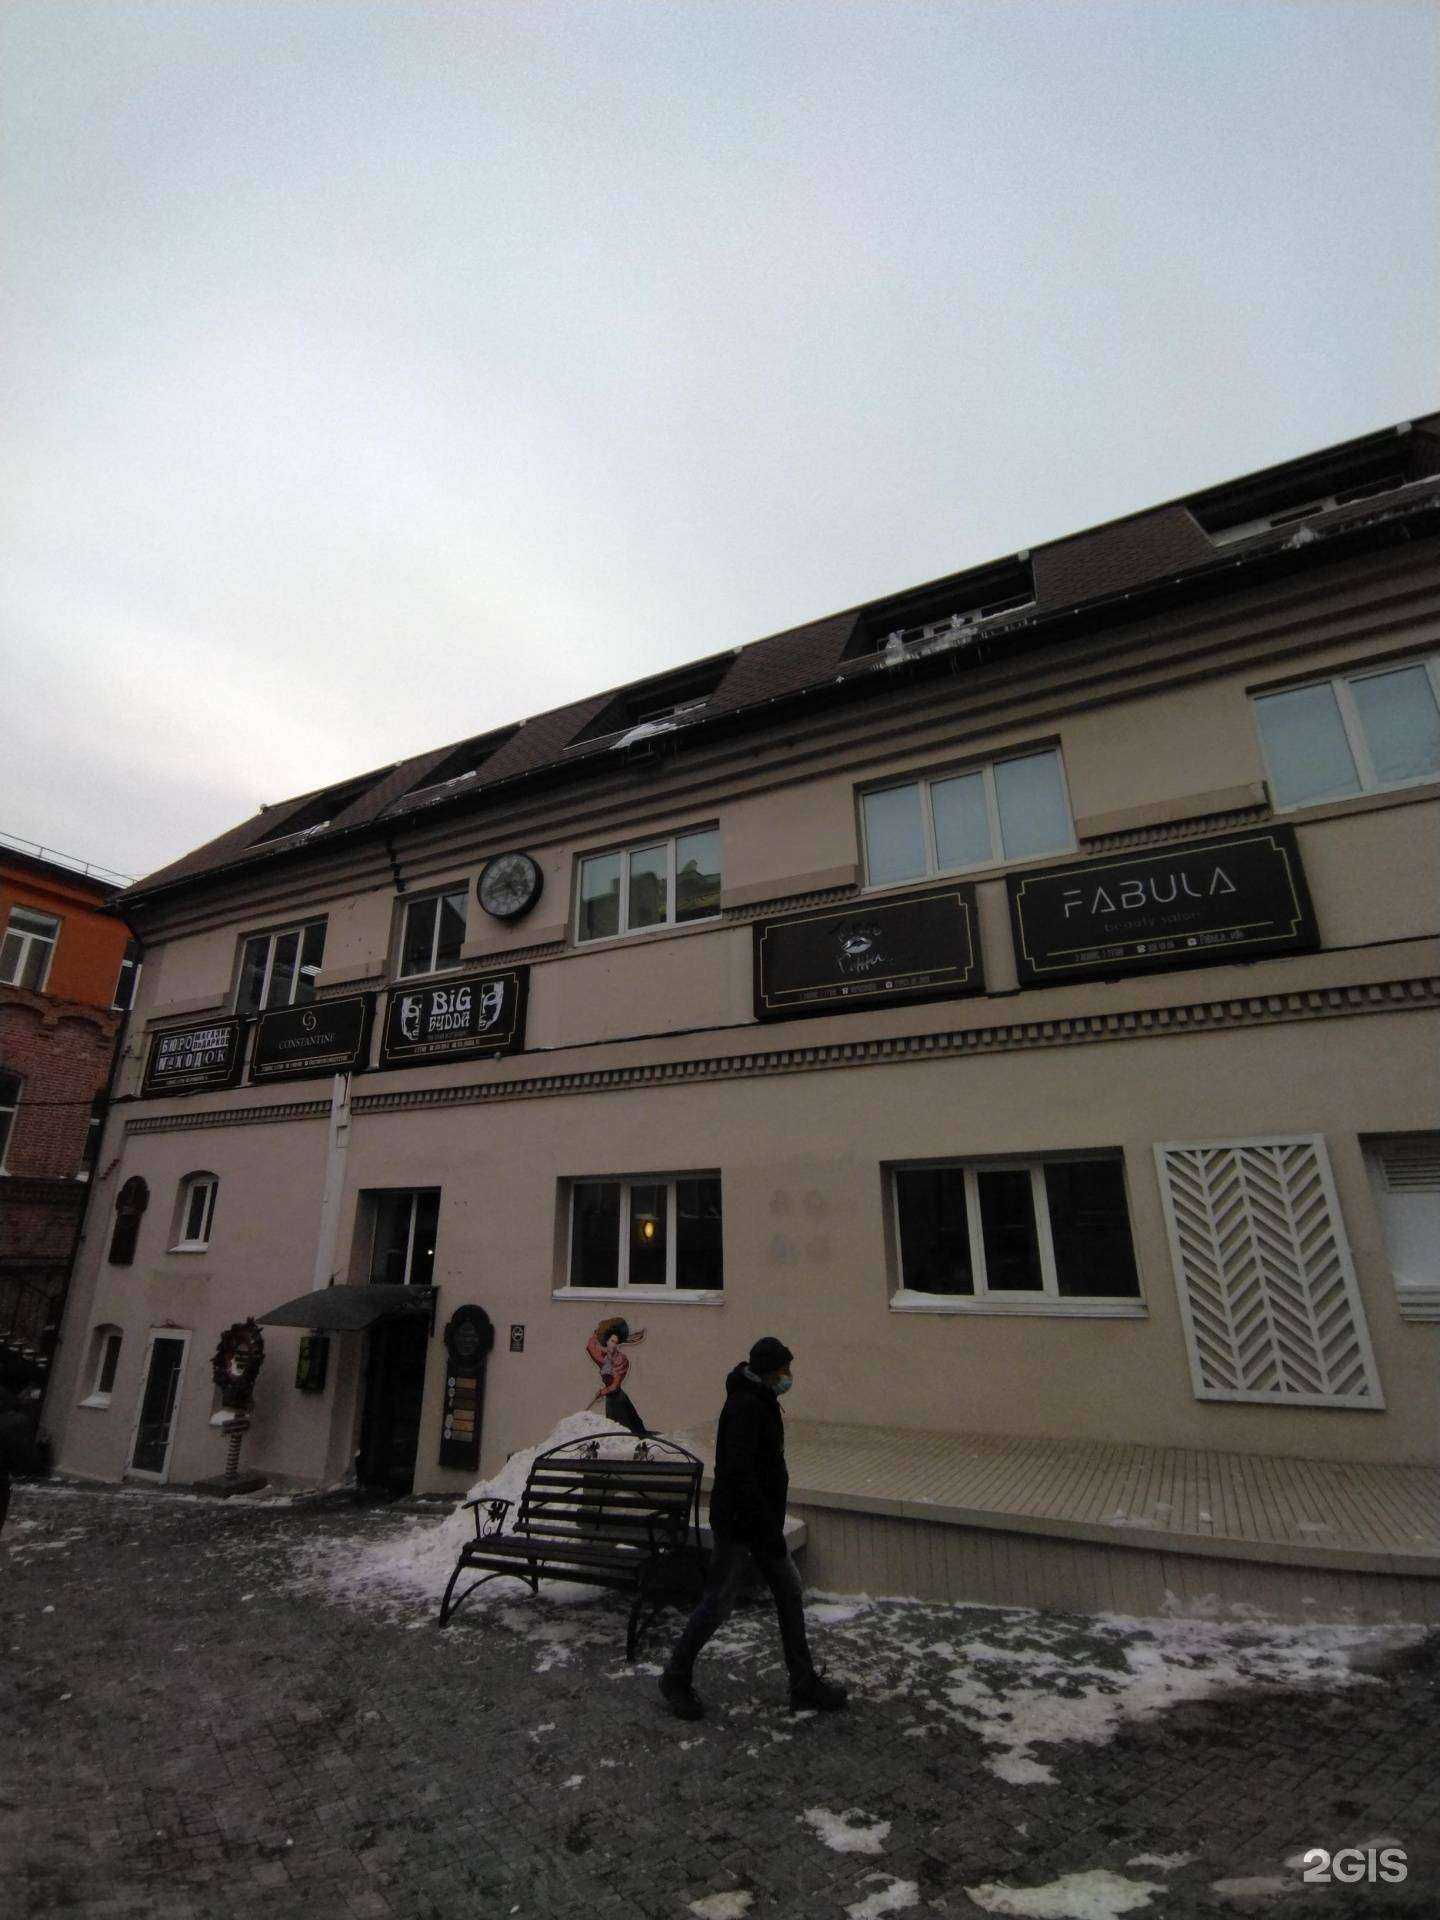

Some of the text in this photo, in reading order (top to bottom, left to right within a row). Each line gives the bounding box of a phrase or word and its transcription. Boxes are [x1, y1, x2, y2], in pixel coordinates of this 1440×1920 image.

[1062, 866, 1236, 919] FABULA
[1104, 911, 1201, 933] beauty salon
